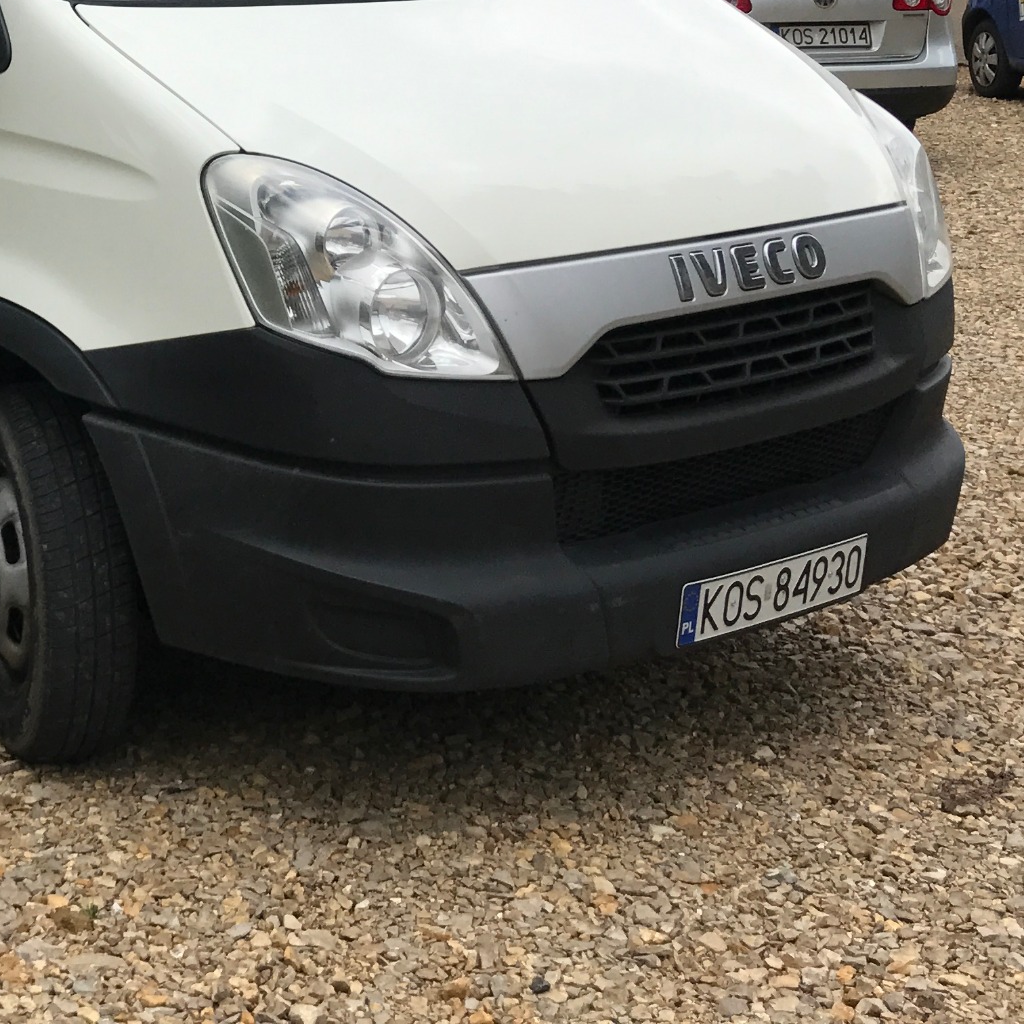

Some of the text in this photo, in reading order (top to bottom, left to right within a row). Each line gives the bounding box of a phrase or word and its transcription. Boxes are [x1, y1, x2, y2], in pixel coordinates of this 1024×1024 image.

[819, 27, 869, 45] 21014
[668, 232, 827, 302] IVECO
[700, 545, 862, 635] KOS 84930
[680, 621, 694, 636] PL
